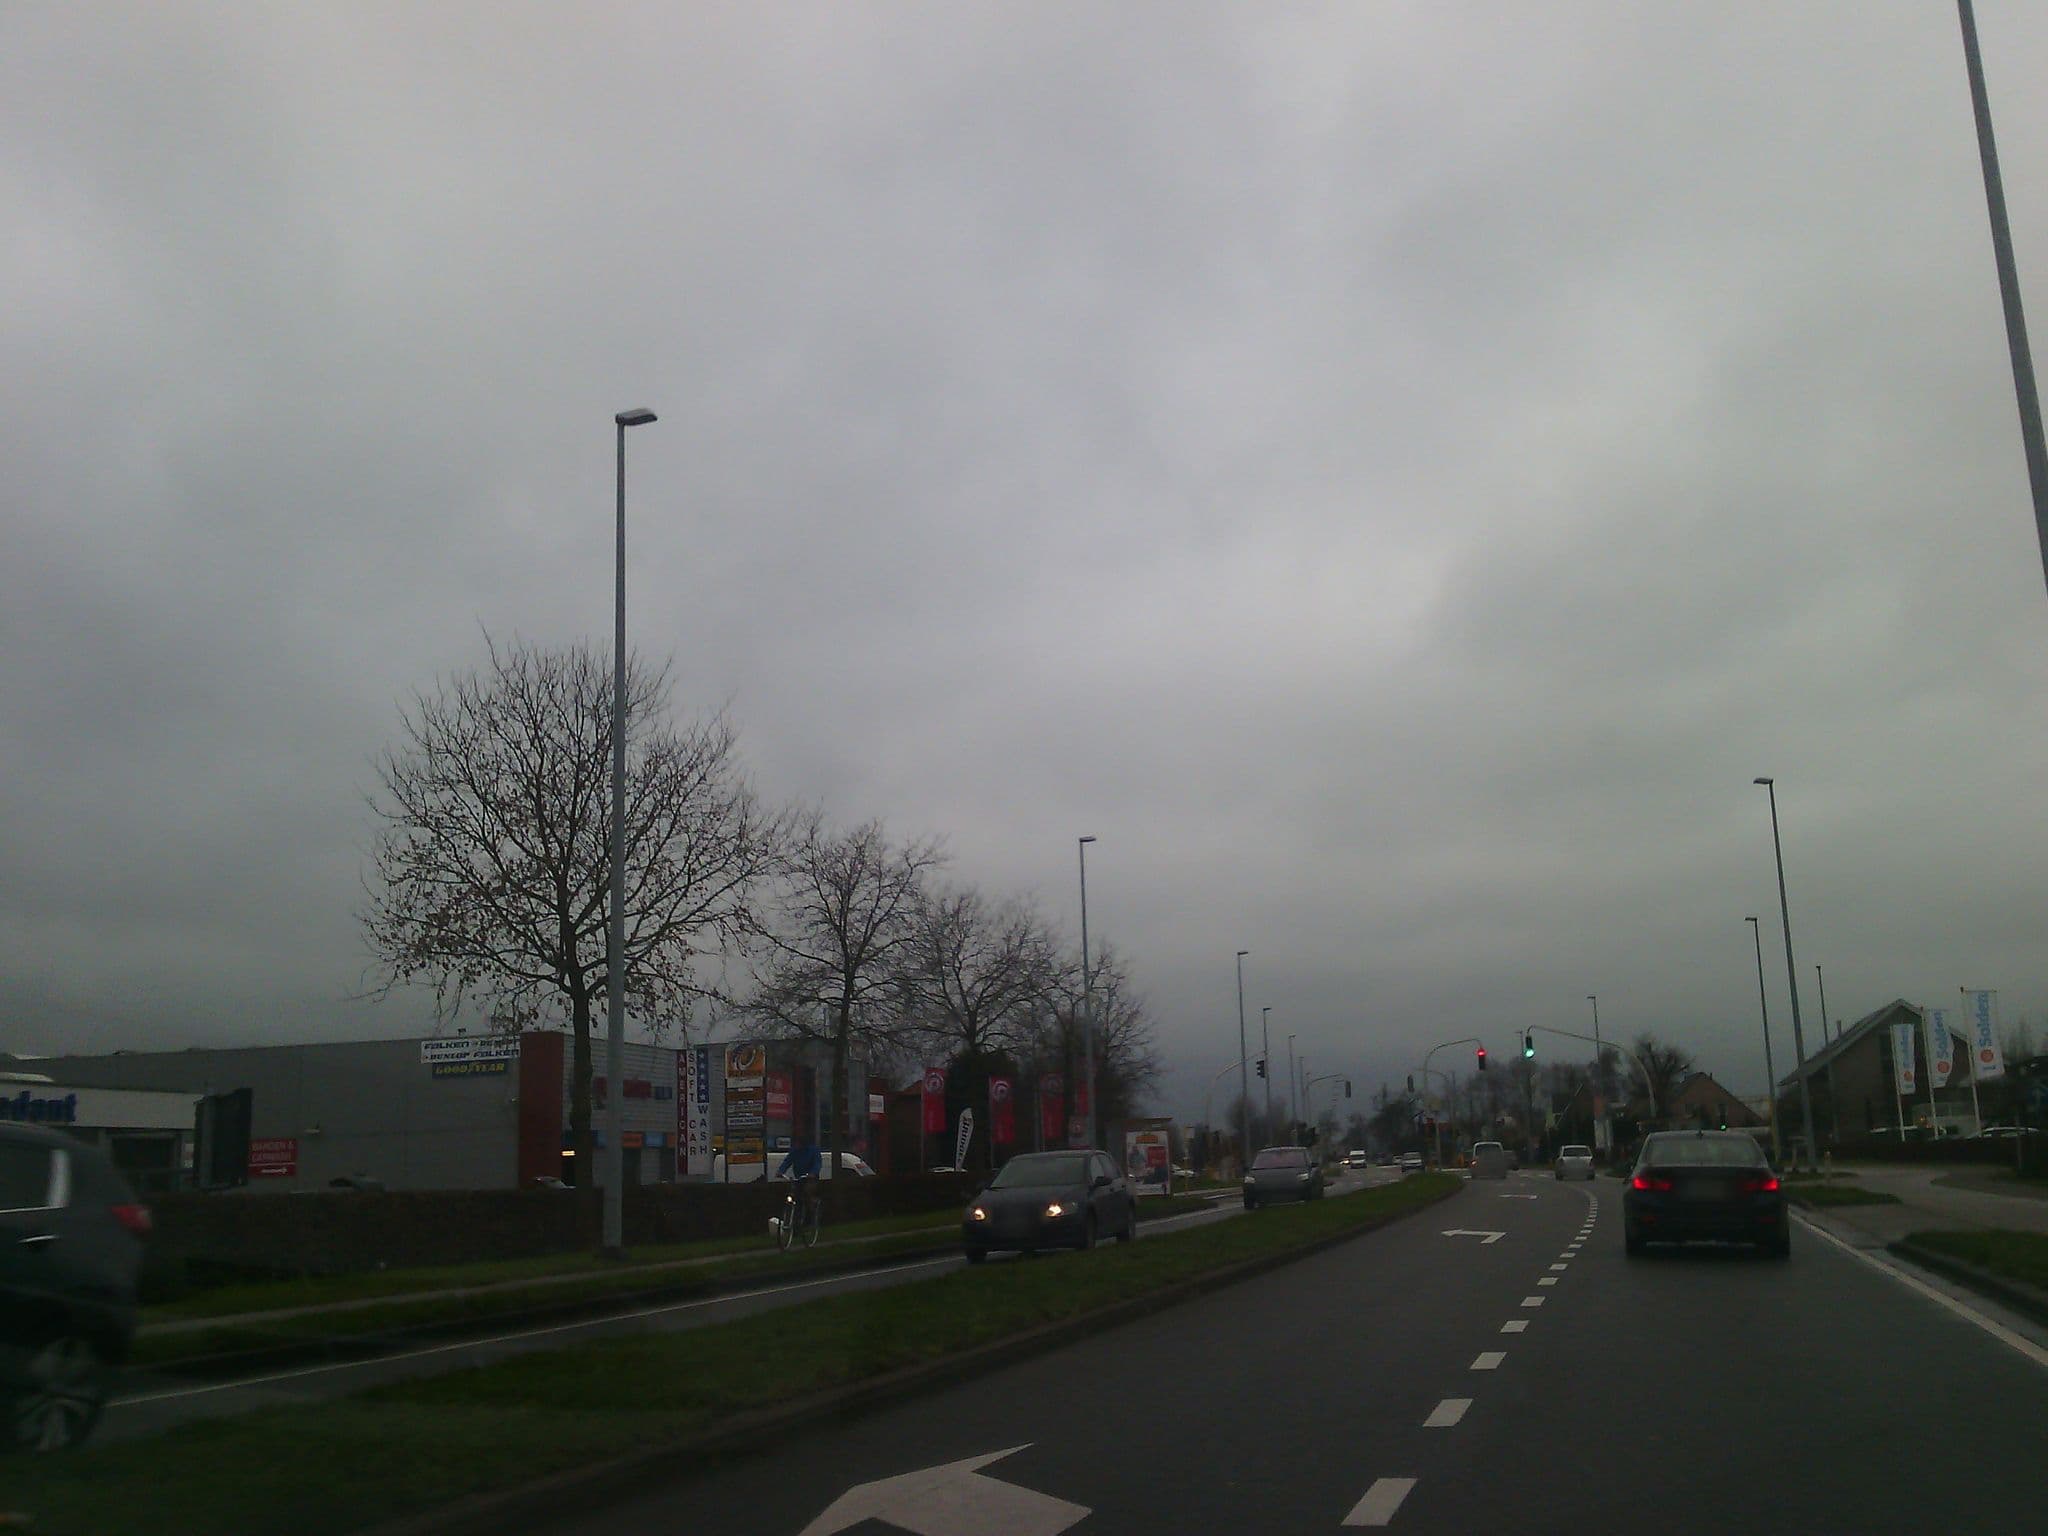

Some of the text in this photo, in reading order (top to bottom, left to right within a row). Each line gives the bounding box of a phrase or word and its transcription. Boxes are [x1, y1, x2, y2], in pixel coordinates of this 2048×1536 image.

[679, 1054, 687, 1157] AMERICAN
[688, 1053, 697, 1156] SOFT CAR
[698, 1105, 709, 1155] WASH
